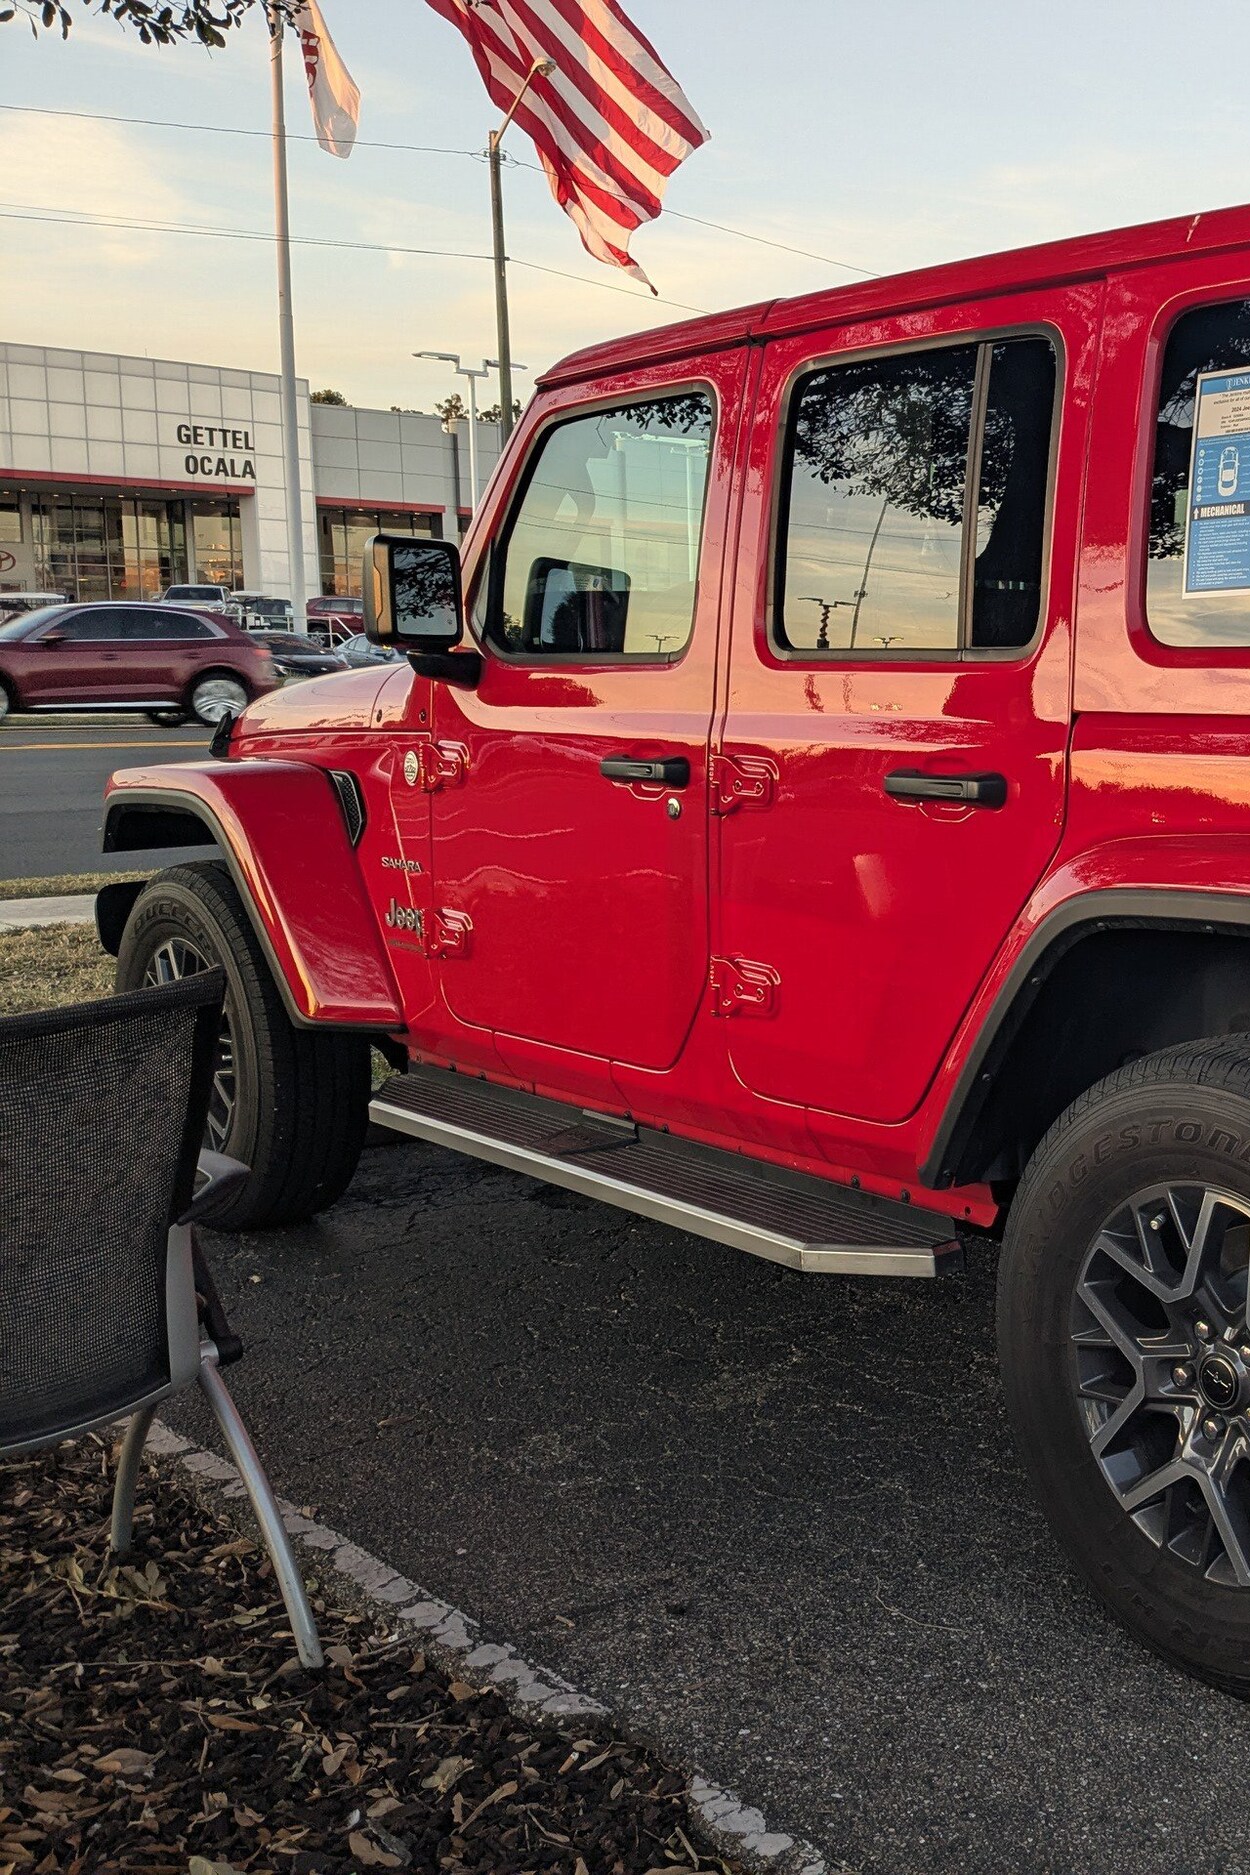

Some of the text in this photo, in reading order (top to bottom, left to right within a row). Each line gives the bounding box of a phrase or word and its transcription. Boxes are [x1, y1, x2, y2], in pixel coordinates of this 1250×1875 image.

[177, 424, 255, 451] GETTEL
[185, 455, 256, 480] OCALA
[1200, 503, 1245, 518] MECHANICAL
[381, 856, 422, 873] SAHARA
[385, 898, 422, 938] Jeep
